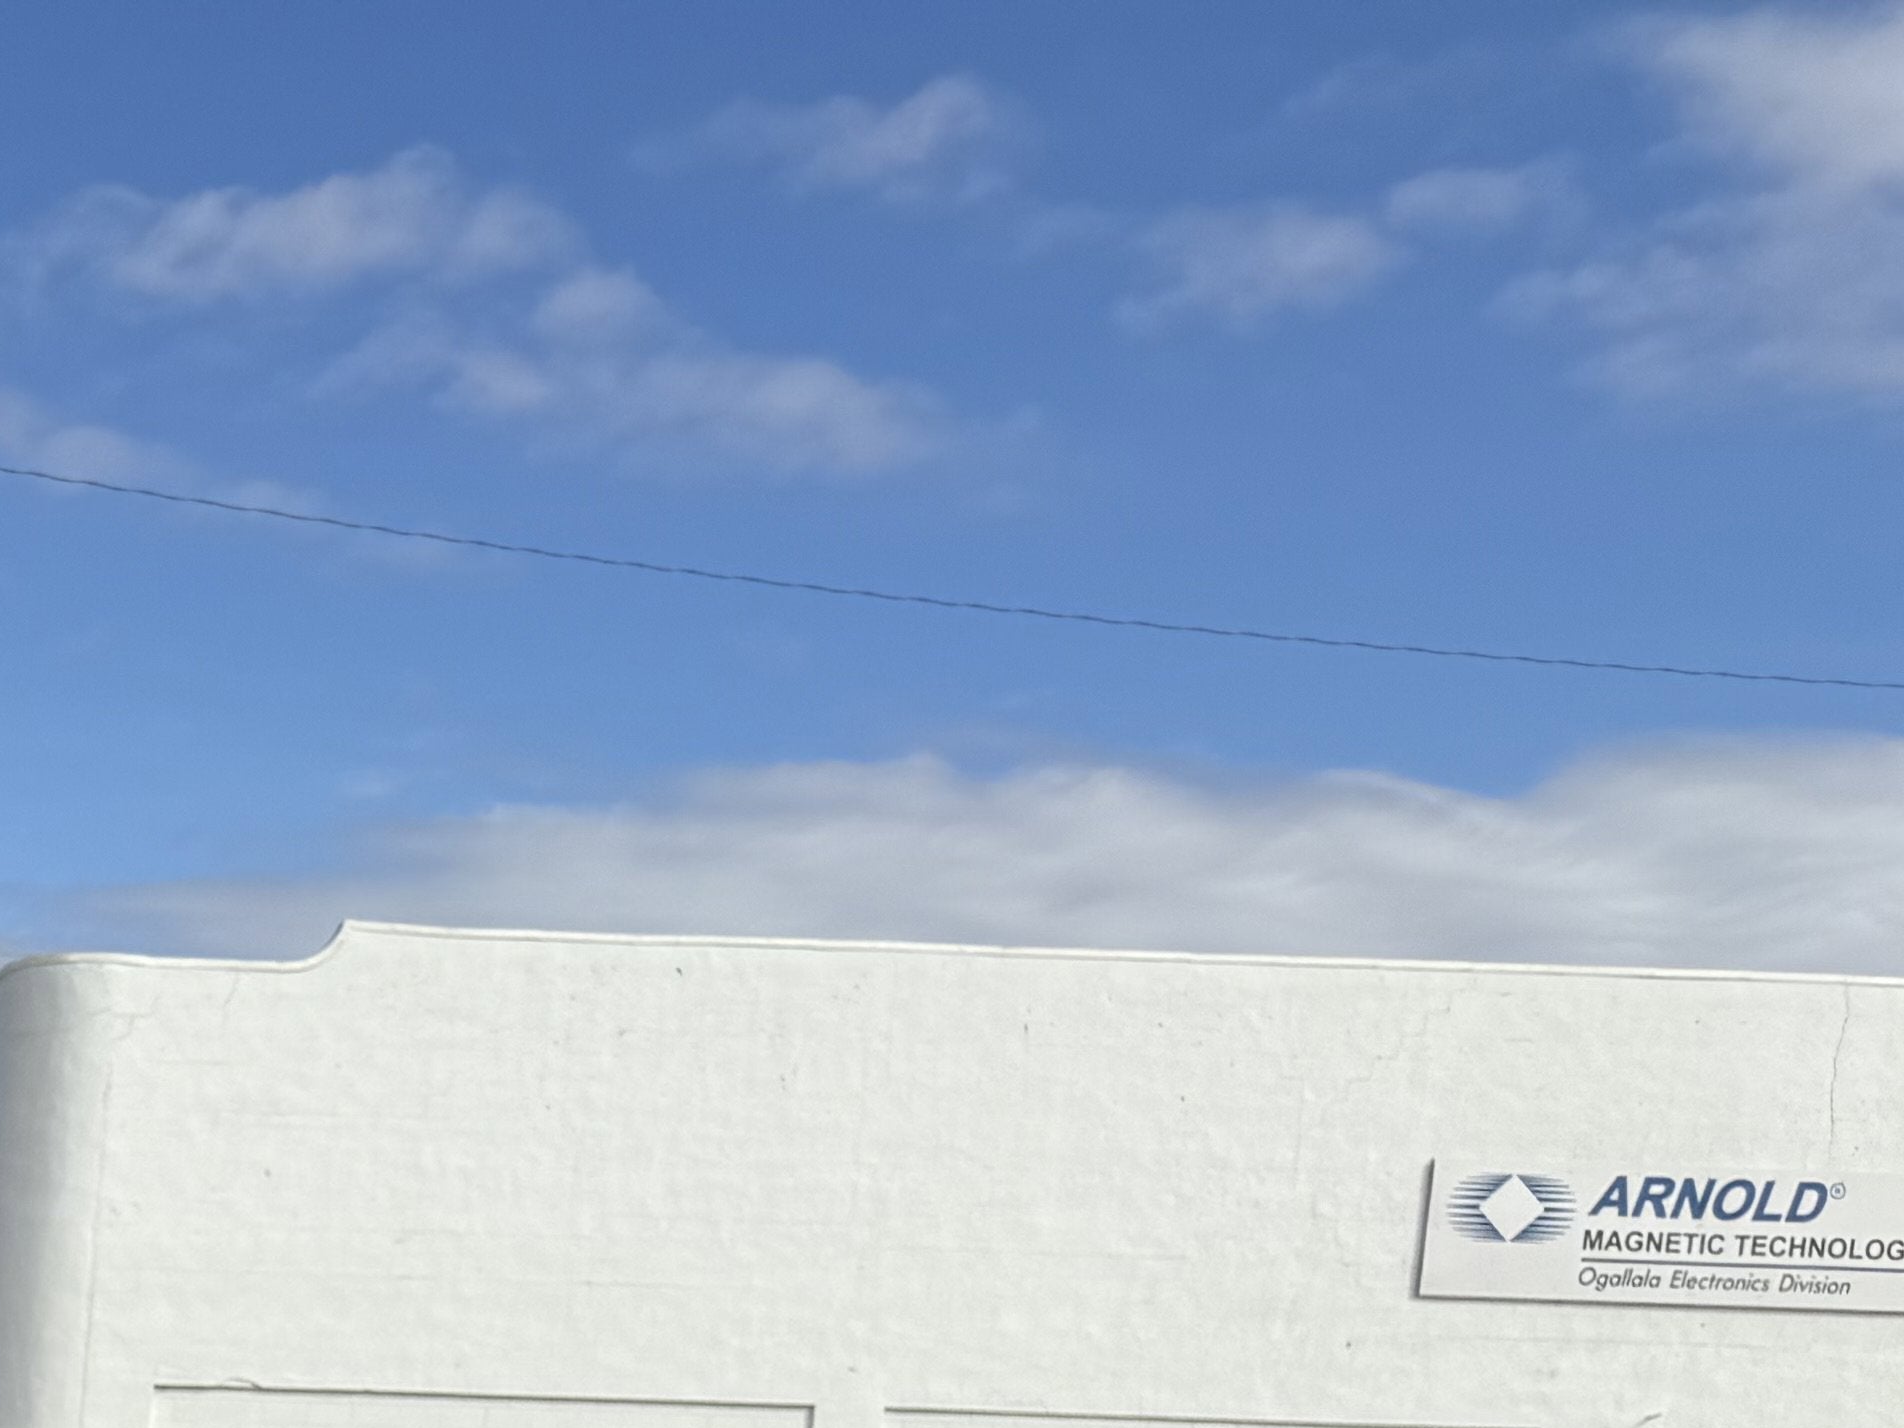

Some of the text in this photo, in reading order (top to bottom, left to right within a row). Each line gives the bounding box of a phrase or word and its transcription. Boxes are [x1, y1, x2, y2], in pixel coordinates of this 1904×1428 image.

[1581, 1229, 1904, 1261] MAGNETIC TECHNOLOG
[1578, 1266, 1852, 1296] Ogallala Electronics Division
